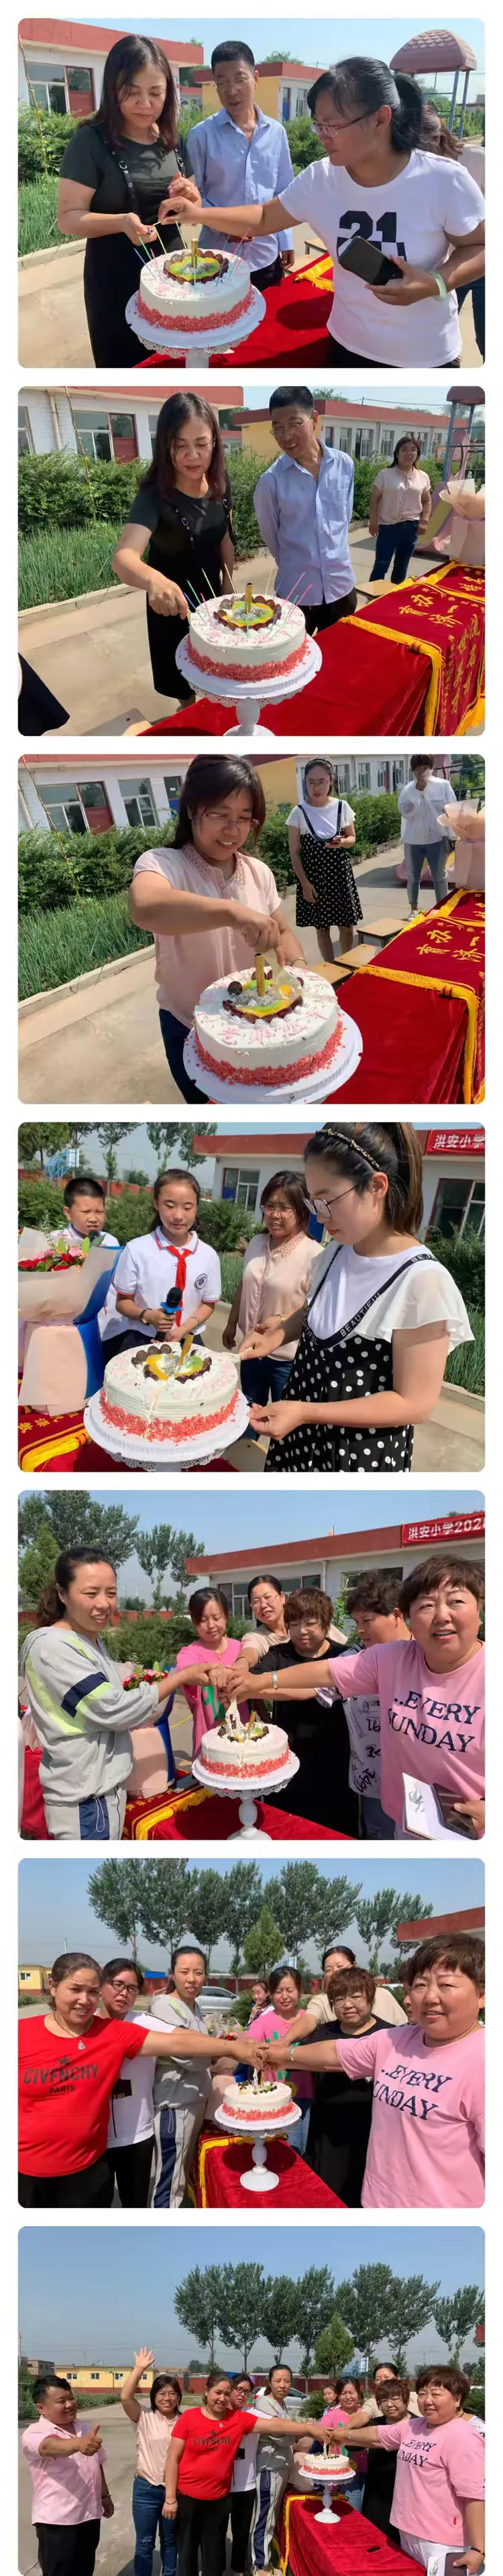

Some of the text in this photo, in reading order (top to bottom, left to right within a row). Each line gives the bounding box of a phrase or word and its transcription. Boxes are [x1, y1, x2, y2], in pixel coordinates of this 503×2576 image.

[434, 1134, 485, 1149] 洪安小学
[408, 1517, 485, 1541] 洪安小学202
[49, 2085, 76, 2094] PARIS
